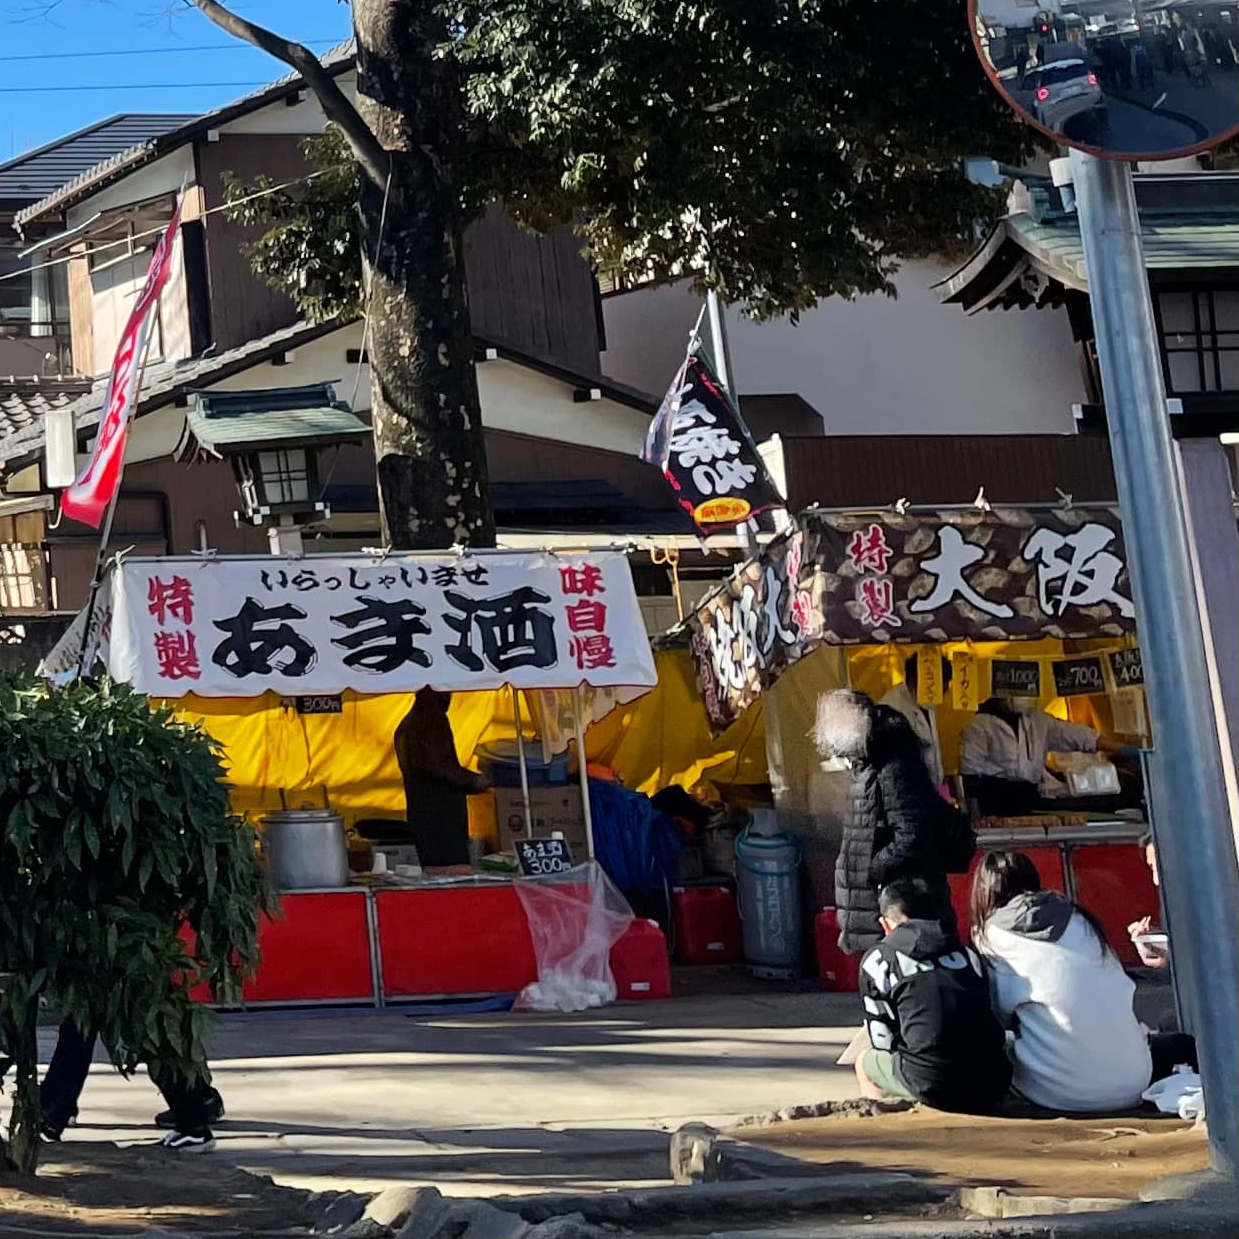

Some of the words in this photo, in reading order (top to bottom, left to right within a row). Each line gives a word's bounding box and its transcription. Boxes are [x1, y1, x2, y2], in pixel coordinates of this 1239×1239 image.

[260, 565, 490, 591] いらっしゃいませ
[558, 563, 618, 669] 味自慢
[848, 524, 902, 628] 特製
[910, 522, 1136, 618] 大阪
[147, 575, 202, 680] 特製
[211, 585, 558, 676] あま酒
